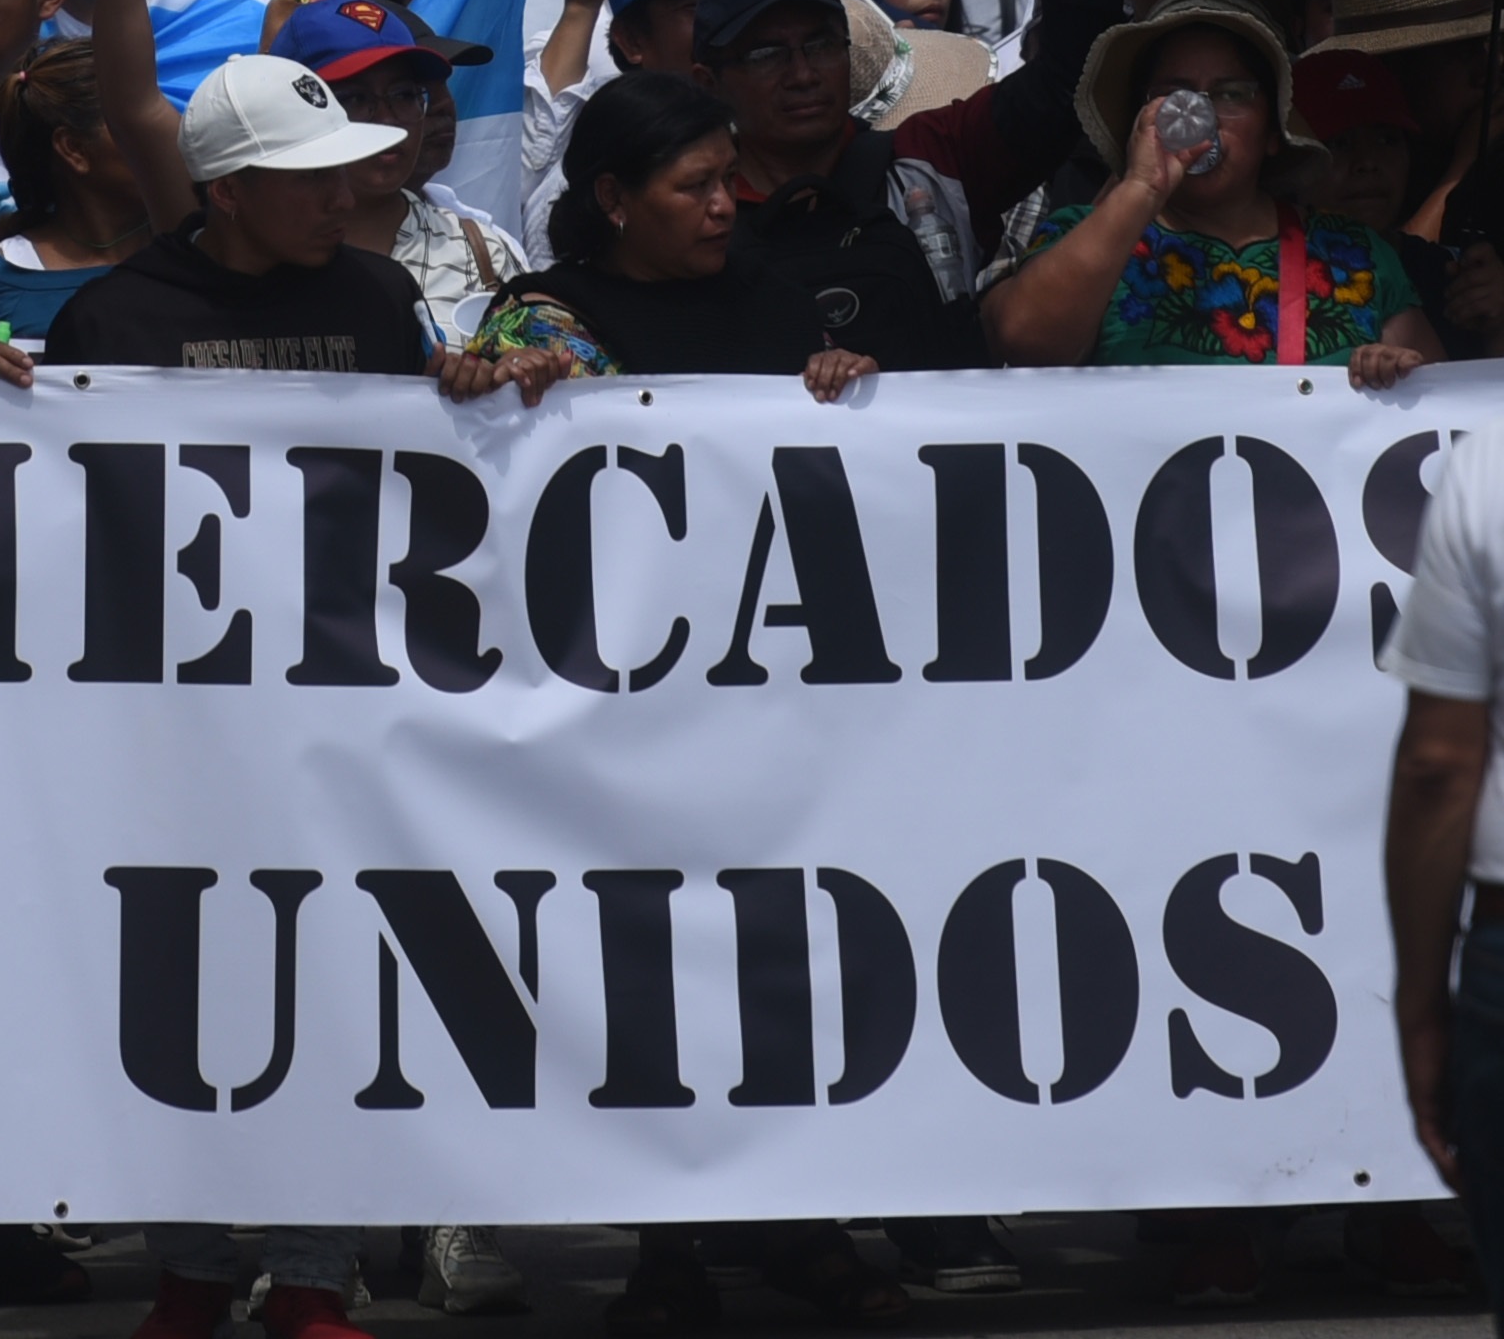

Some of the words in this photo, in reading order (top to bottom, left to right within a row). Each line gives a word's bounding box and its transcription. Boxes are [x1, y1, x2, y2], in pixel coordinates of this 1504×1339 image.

[182, 338, 301, 371] CHESAPEAKE
[303, 335, 359, 373] ELITE
[104, 853, 1337, 1111] UNIDOS
